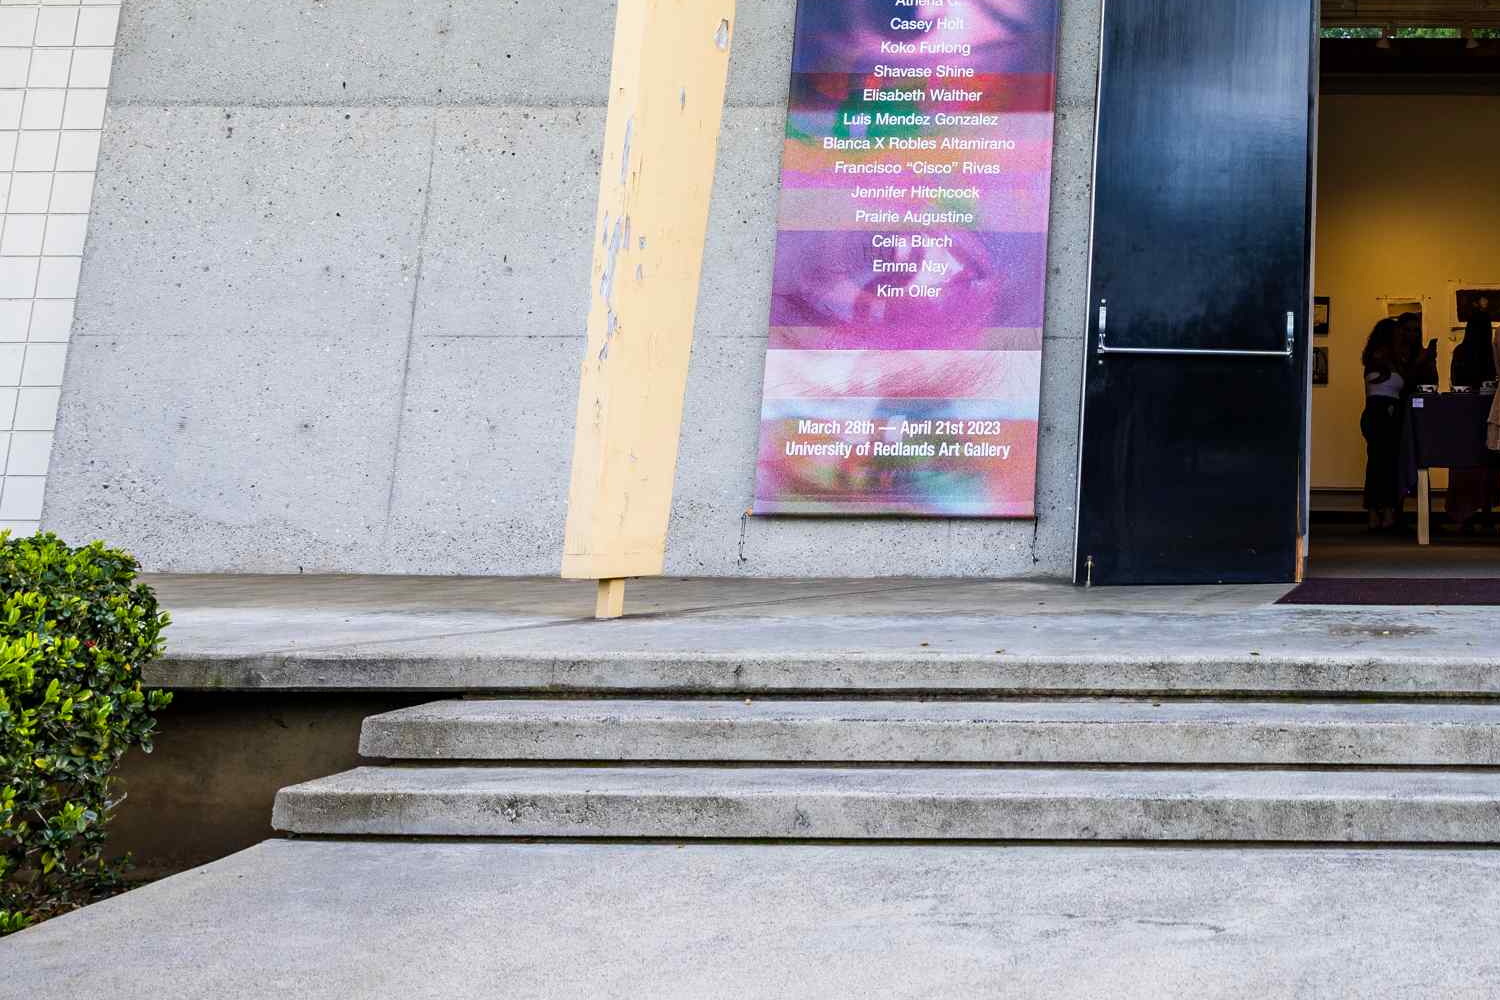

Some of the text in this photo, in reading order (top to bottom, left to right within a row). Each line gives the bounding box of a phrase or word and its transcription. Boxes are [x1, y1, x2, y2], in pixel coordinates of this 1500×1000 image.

[890, 17, 964, 33] Casey Holt
[880, 41, 971, 56] Koko Furlong
[874, 64, 974, 77] Shavase Shine
[863, 88, 982, 102] Elisabeth Walther
[843, 112, 998, 126] Luis Mendez Gonzalez
[824, 137, 1015, 151] Blanca X Robles Altamirano
[834, 161, 902, 175] Francisco
[962, 161, 1000, 175] Rivas
[851, 185, 980, 200] Jennifer Hitchcock
[855, 210, 973, 226] Prairie Augustine
[872, 234, 952, 248] Celia Burch
[872, 260, 949, 276] Emma Nay
[877, 284, 941, 298] Kim Oller
[798, 420, 841, 435] March
[845, 420, 874, 434] 28th
[900, 420, 931, 437] April
[935, 420, 964, 436] 21st
[967, 421, 1001, 435] 2023
[785, 441, 1010, 459] University of Redlands Art Gallery
